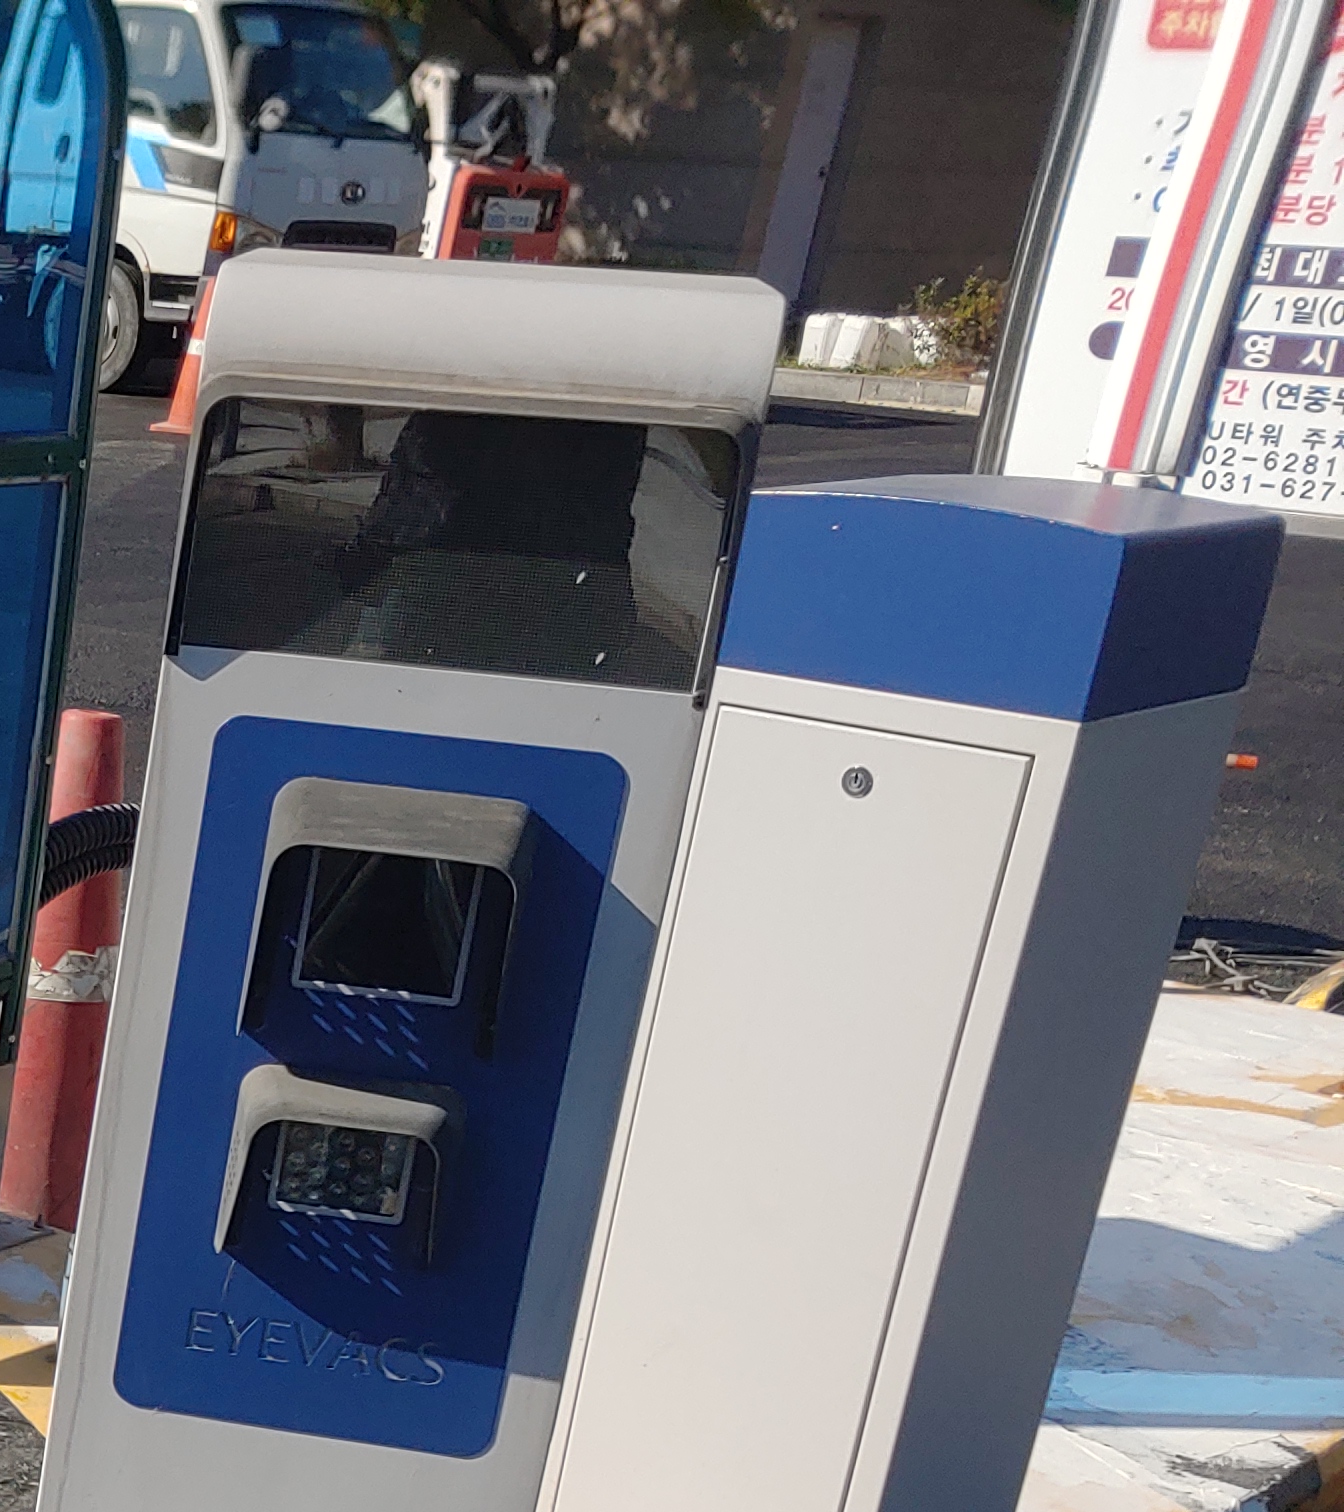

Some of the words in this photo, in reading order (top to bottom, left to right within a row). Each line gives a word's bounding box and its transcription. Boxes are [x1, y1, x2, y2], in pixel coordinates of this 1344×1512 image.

[1273, 194, 1338, 226] 분당
[1201, 445, 1337, 477] 02-6281
[1201, 469, 1344, 502] 031-627
[184, 1308, 446, 1386] EYEVACS
